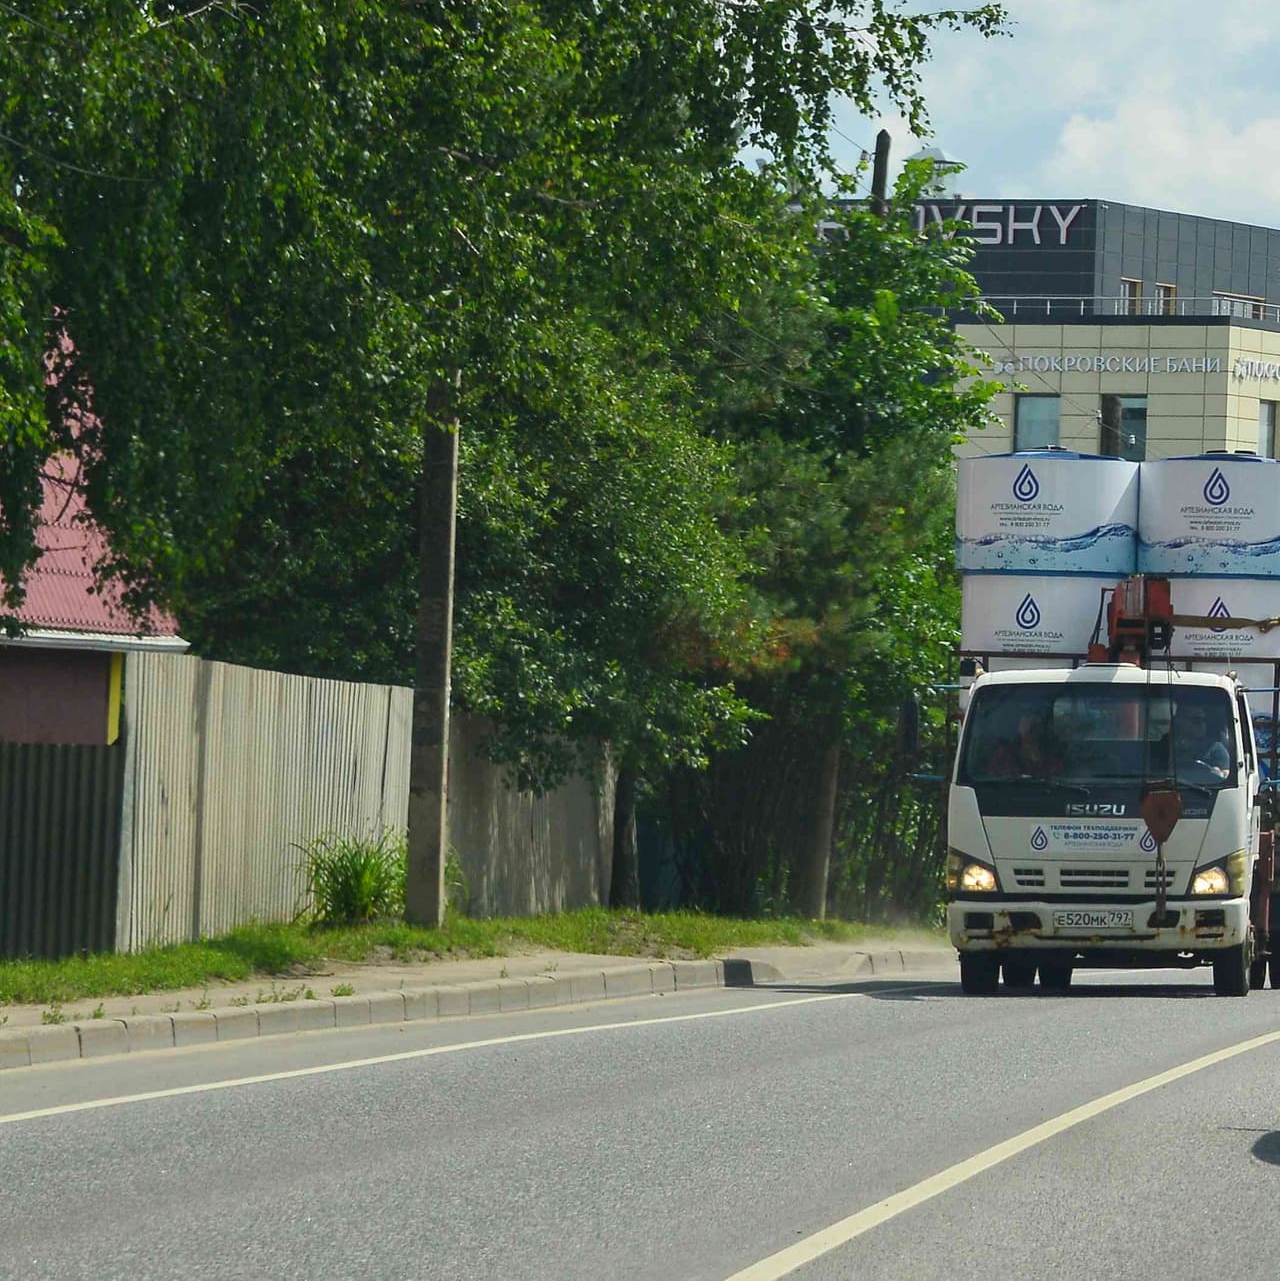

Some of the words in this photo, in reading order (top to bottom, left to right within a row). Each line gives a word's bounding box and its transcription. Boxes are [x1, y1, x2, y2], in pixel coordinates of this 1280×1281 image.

[1019, 355, 1161, 373] ПОКРОВСКИЕ
[1166, 356, 1222, 374] БАНИ
[1066, 804, 1126, 815] ISUZU
